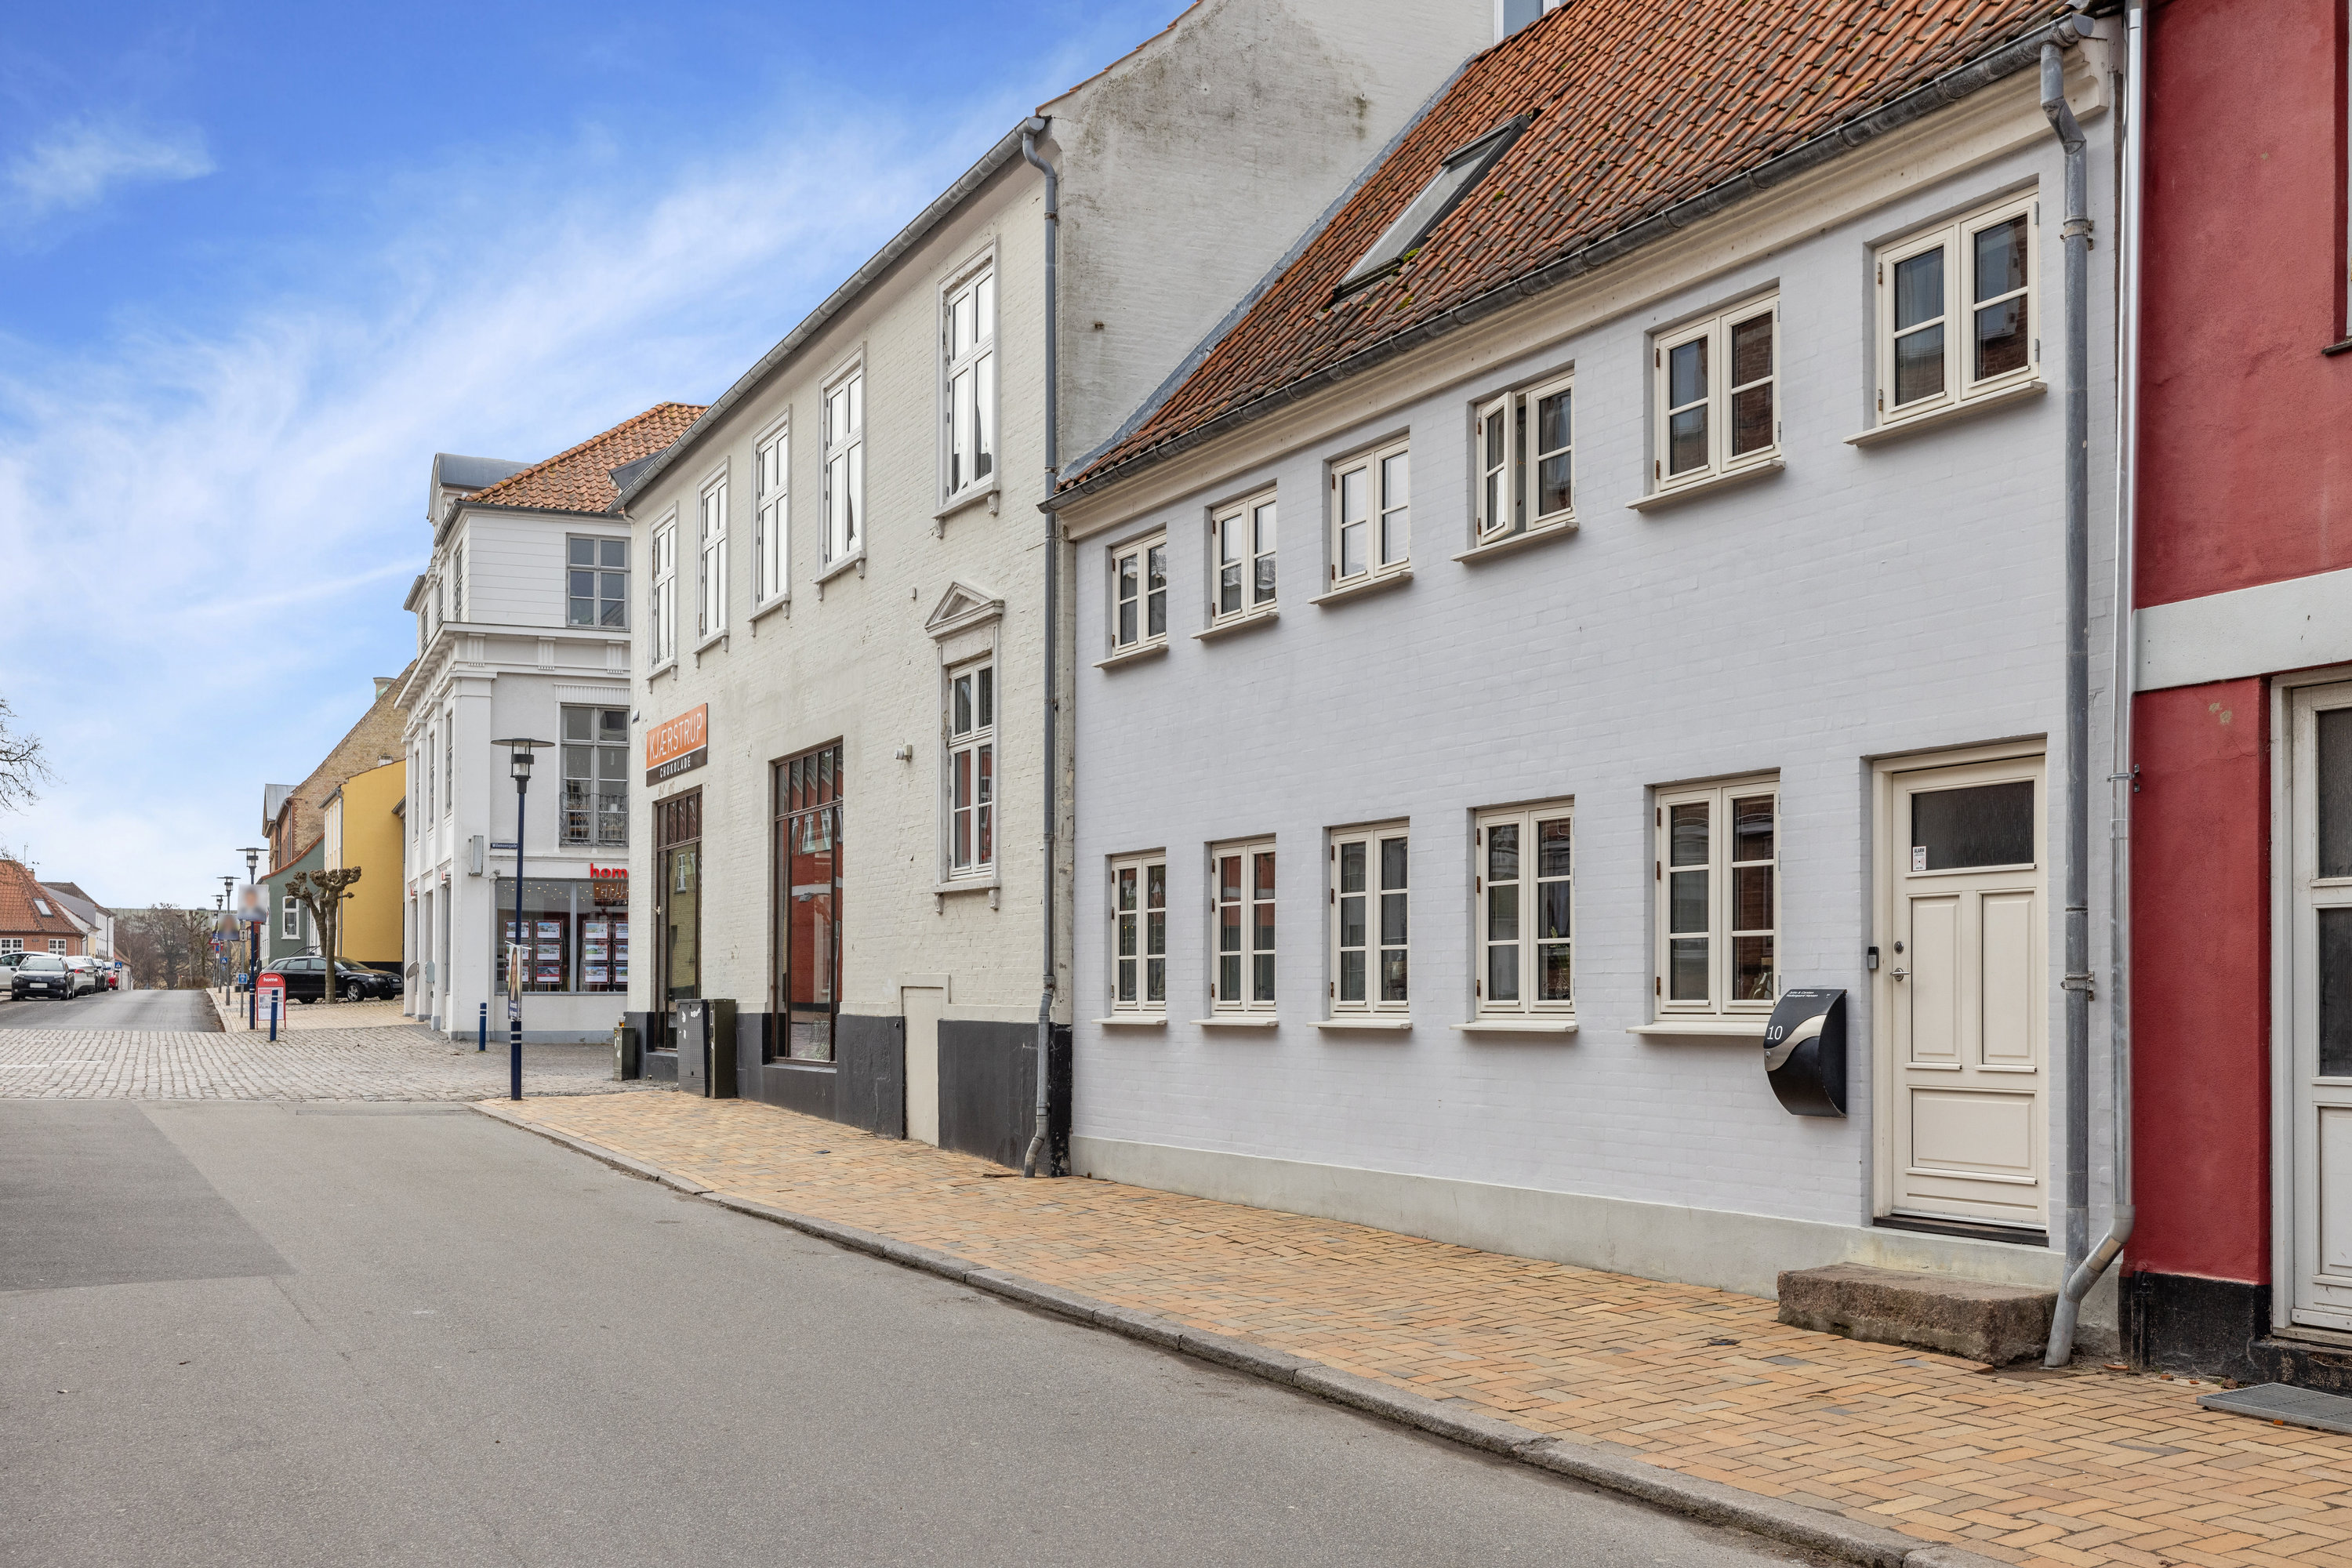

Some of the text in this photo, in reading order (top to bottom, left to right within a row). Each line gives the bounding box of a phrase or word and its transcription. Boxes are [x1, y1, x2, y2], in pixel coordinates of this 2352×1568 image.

[649, 712, 702, 762] KJÆRSTRUP
[659, 756, 691, 779] CHOKOLADE
[590, 862, 628, 878] hom
[1766, 1025, 1783, 1040] 10
